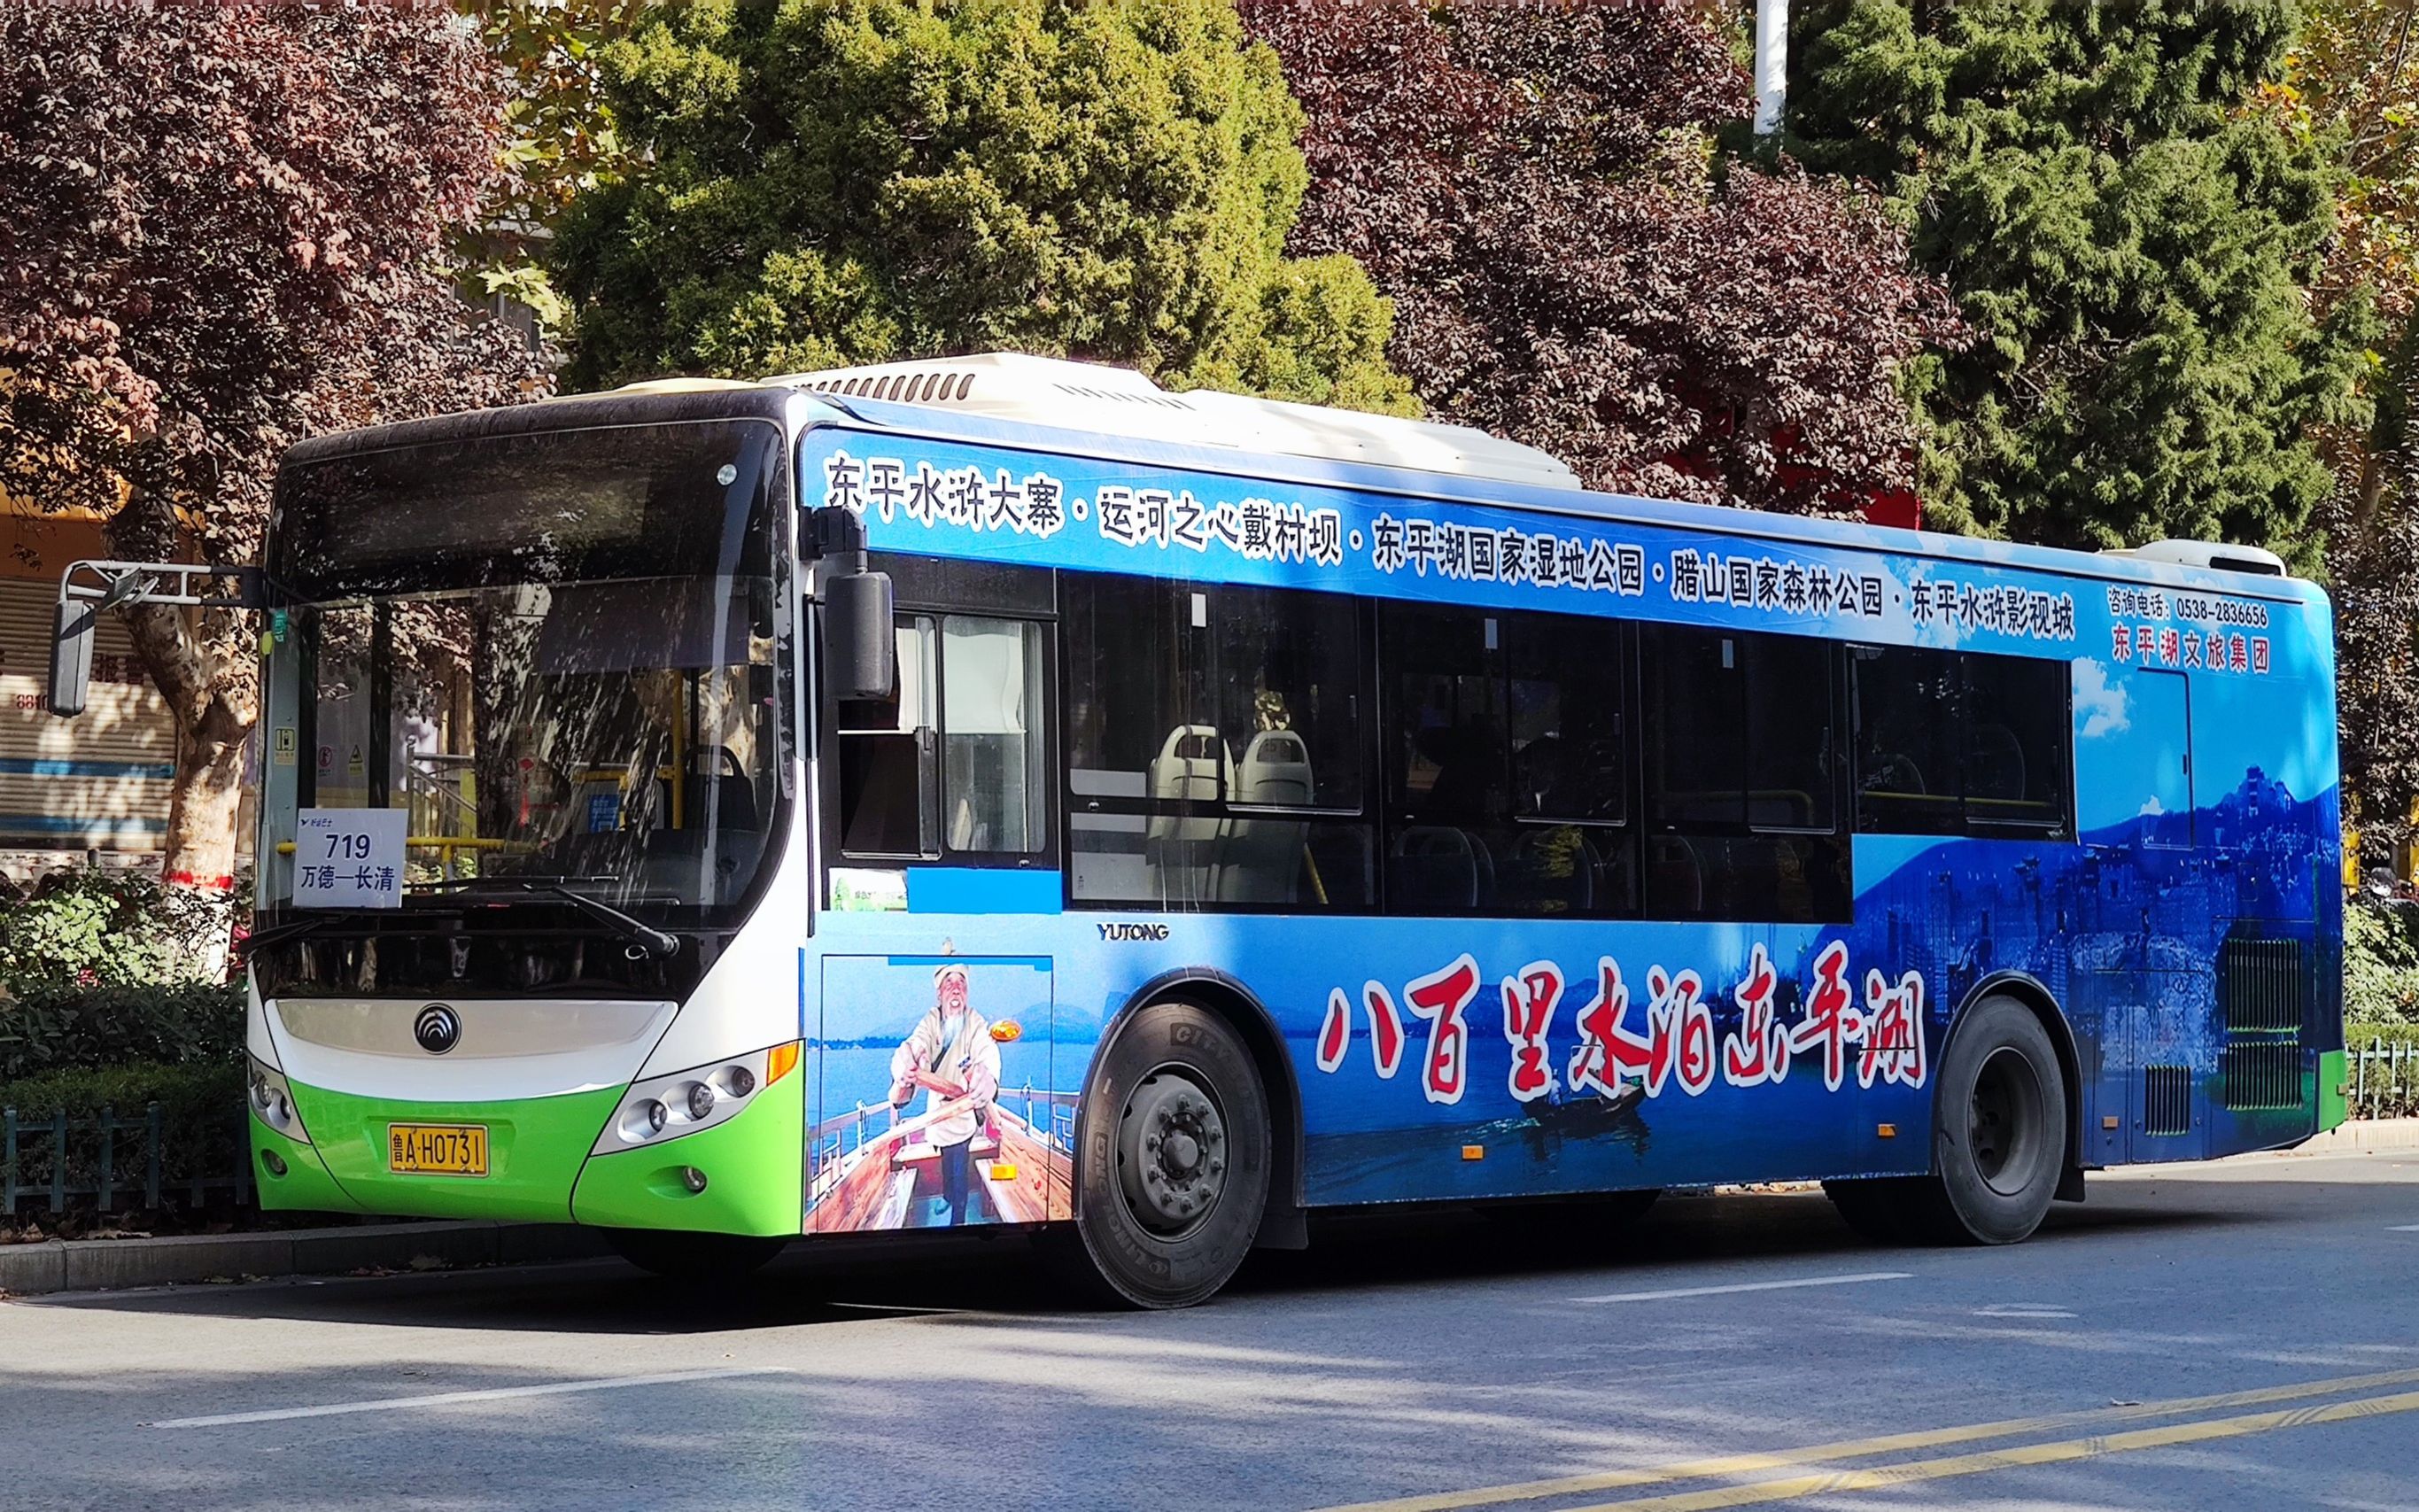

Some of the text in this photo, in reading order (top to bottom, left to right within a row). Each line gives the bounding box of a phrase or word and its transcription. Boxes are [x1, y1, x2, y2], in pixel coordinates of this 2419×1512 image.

[827, 455, 2074, 636] 东平水浒大寨 运河之心戴村坝 东平湖国家湿地公园 腊山国家森林公园 东平水浒影视城
[2176, 597, 2268, 627] 0538-2836656
[2113, 624, 2270, 672] 东平湖文旅集团
[325, 834, 371, 859] 719
[1097, 923, 1170, 941] YUTONG
[1318, 942, 1926, 1104] 八百里水泊东平湖
